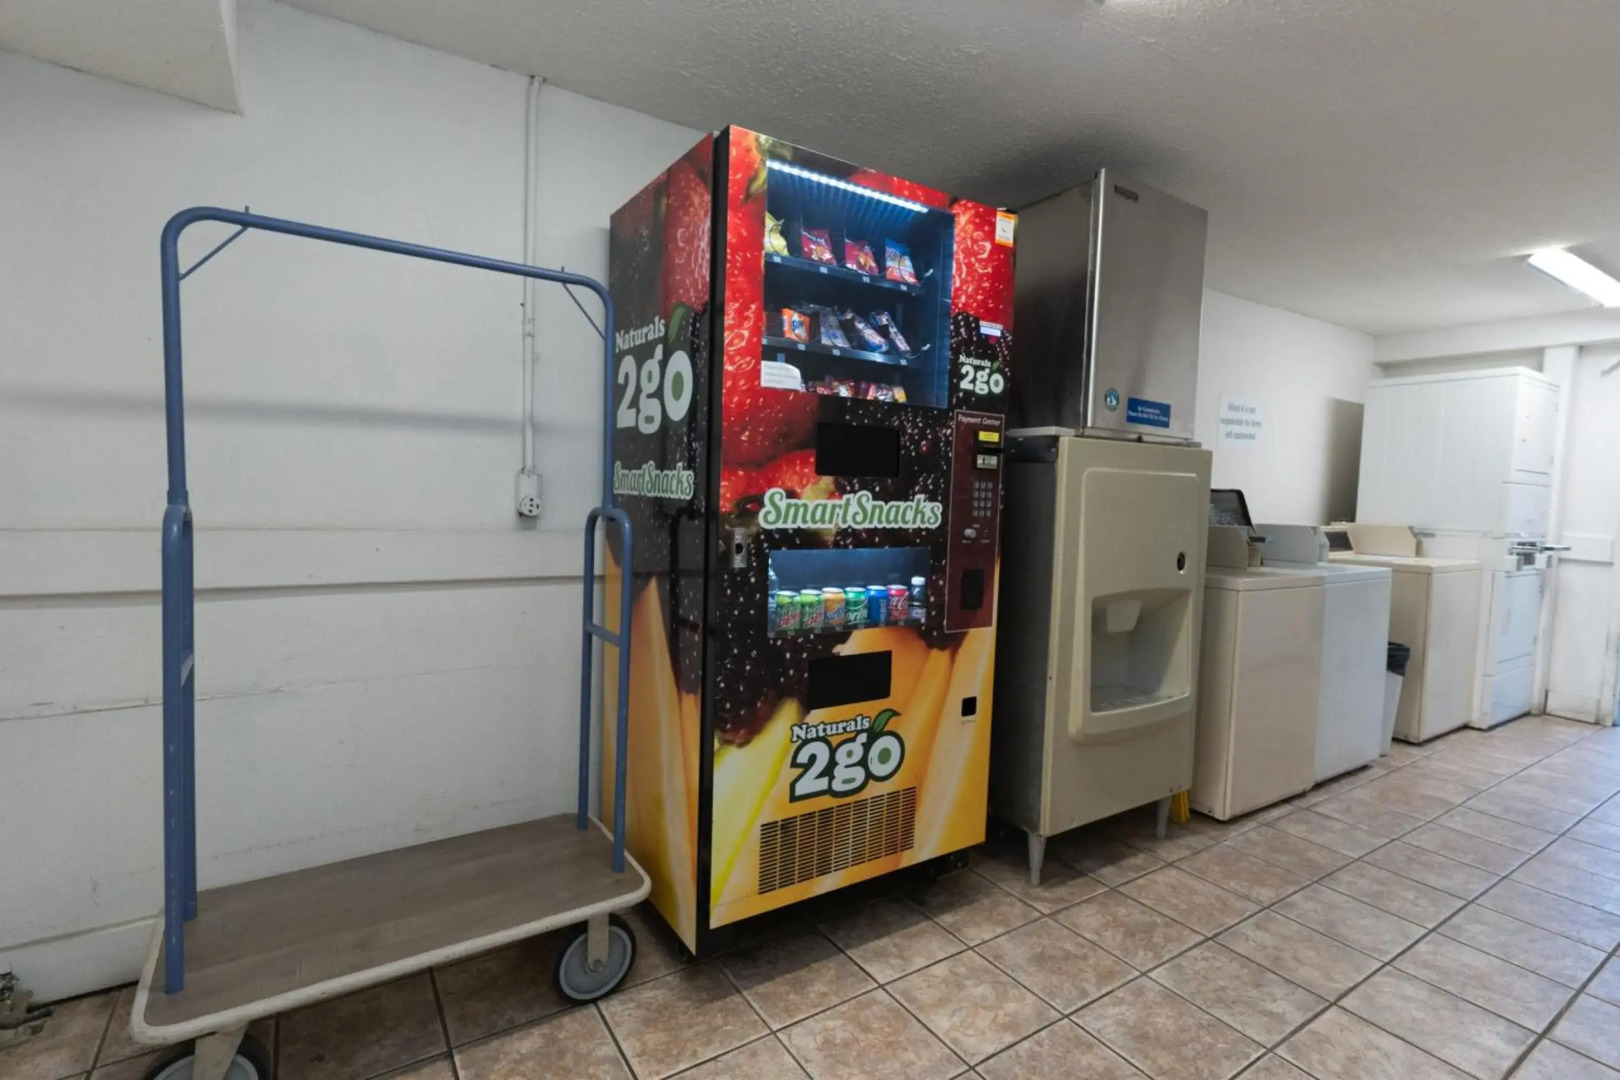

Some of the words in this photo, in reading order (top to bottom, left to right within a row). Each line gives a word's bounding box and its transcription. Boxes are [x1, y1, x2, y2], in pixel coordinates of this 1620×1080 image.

[615, 315, 666, 353] Naturals
[959, 354, 991, 368] Naturals
[960, 364, 1004, 395] 2go
[616, 344, 694, 434] 2go
[958, 414, 981, 425] Payment
[982, 416, 1001, 426] Center
[614, 461, 694, 499] SmartSnacks
[760, 488, 942, 528] SmartSnacks
[792, 715, 871, 742] Naturals
[792, 732, 903, 799] 2go
